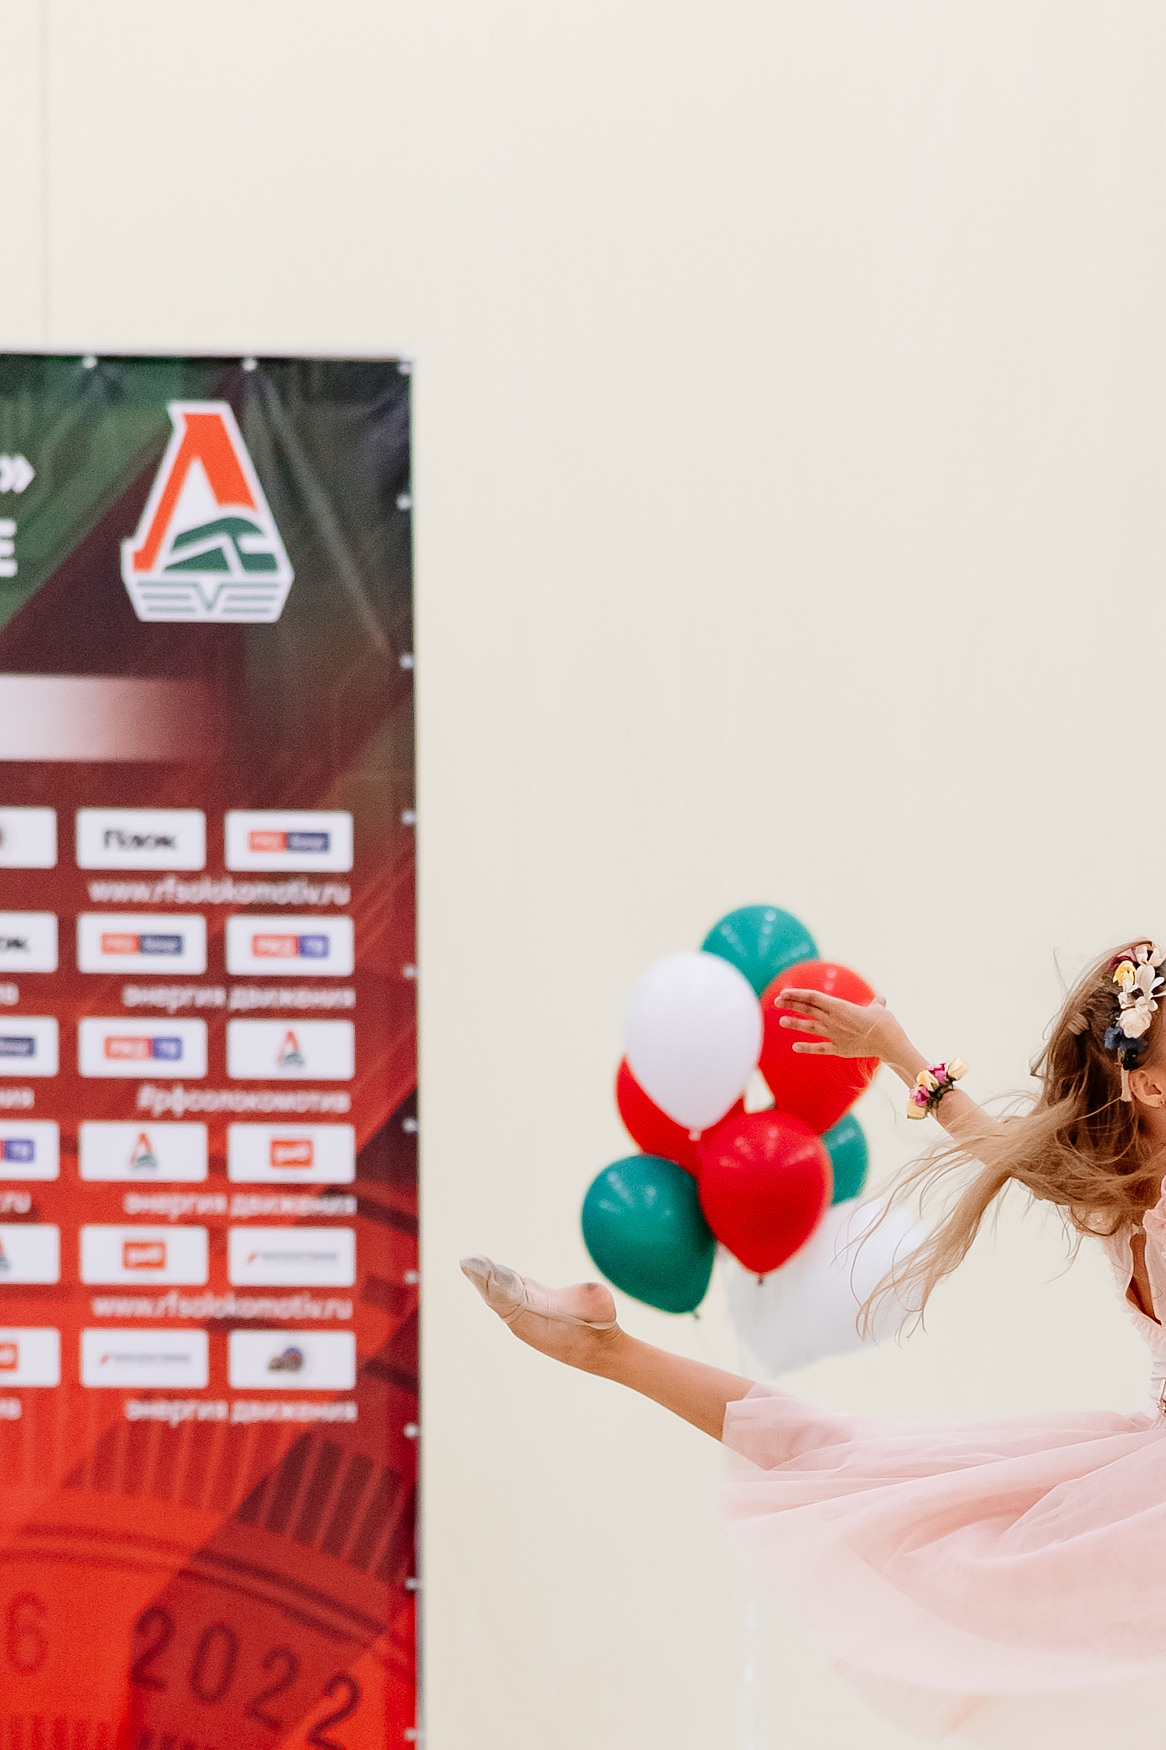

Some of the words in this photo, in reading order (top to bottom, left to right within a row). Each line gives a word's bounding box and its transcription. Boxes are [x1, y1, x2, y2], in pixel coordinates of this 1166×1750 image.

[122, 985, 227, 1014] энергия
[229, 986, 356, 1011] движения
[124, 1193, 228, 1221] энергия
[230, 1194, 357, 1217] движения
[126, 1399, 229, 1428] энергия
[231, 1400, 358, 1423] движения
